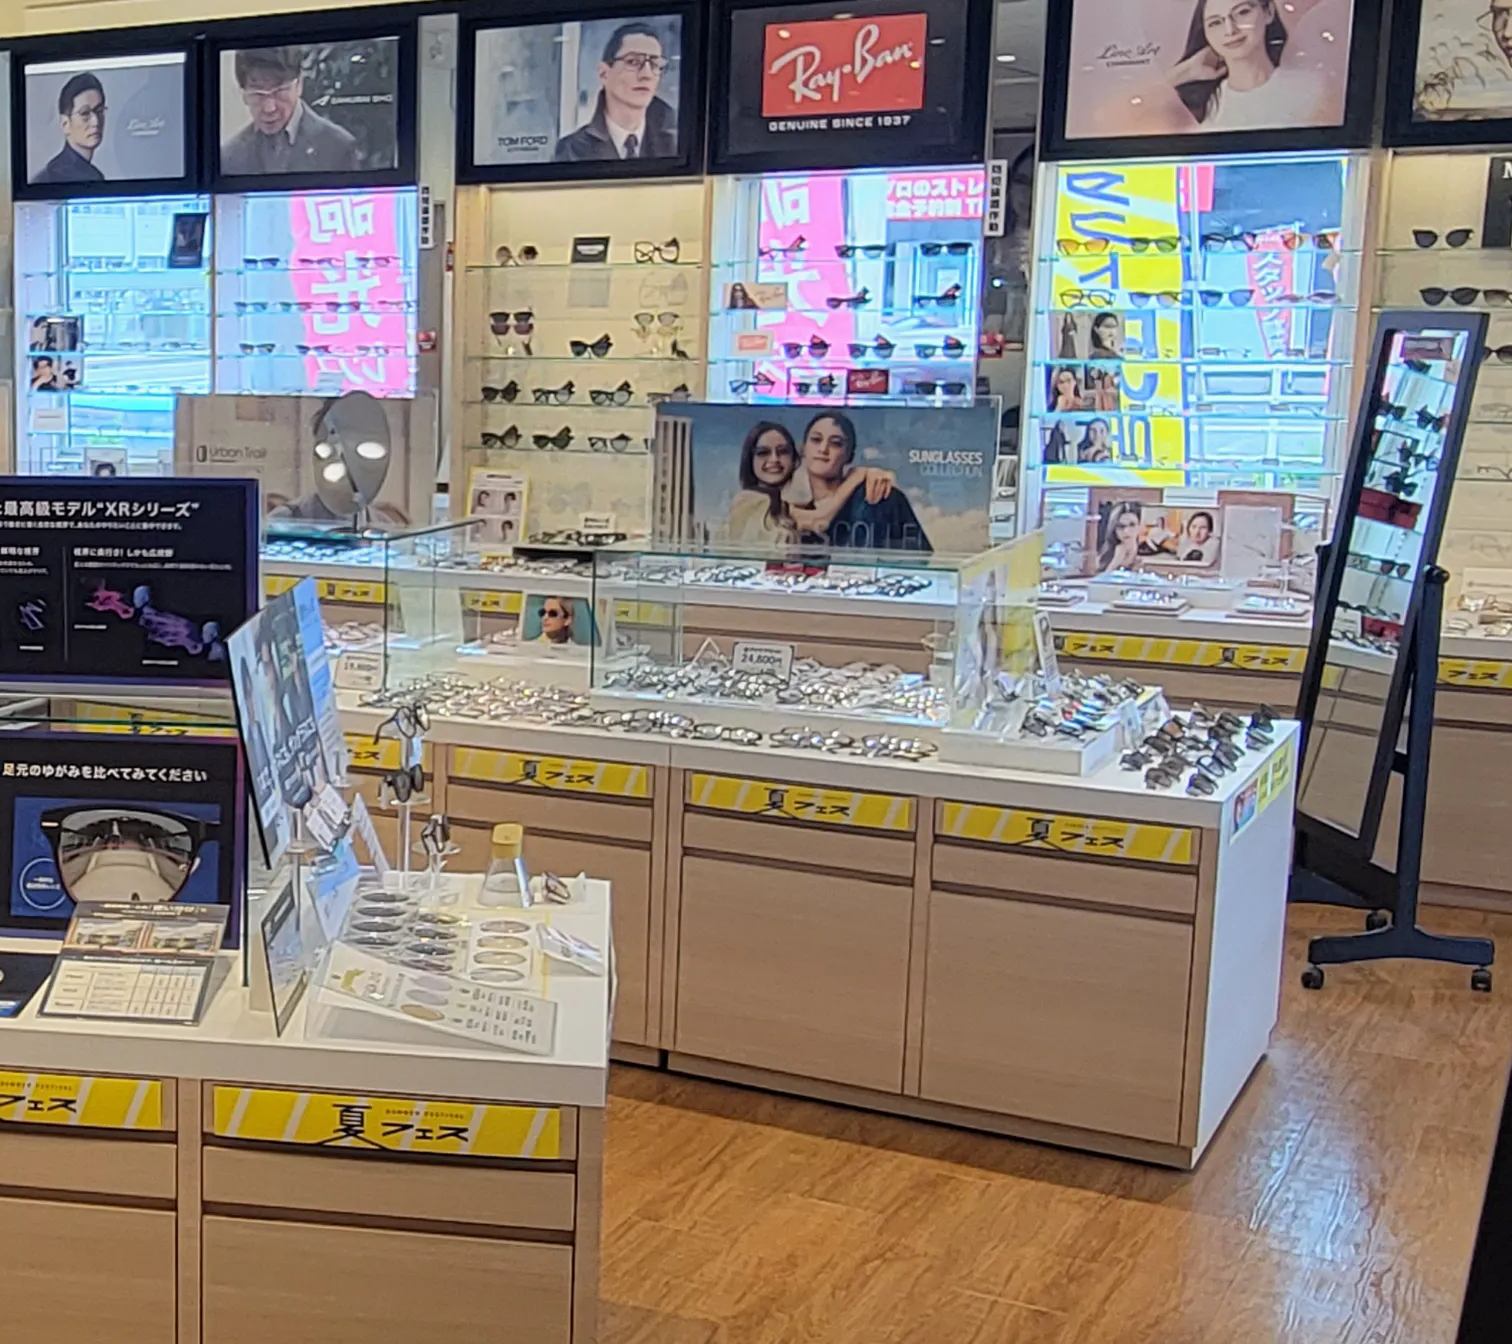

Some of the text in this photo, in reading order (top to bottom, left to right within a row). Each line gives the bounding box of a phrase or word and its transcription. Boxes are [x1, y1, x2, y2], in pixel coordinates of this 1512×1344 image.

[768, 118, 828, 131] GENUINE
[832, 116, 874, 128] SINCE
[210, 446, 243, 458] Urban
[908, 449, 983, 464] SUNGLASSES
[2, 762, 208, 784] 足元のゆがみを比べてみてください
[1021, 818, 1125, 849] 夏フェス
[320, 1103, 469, 1148] 夏フェス
